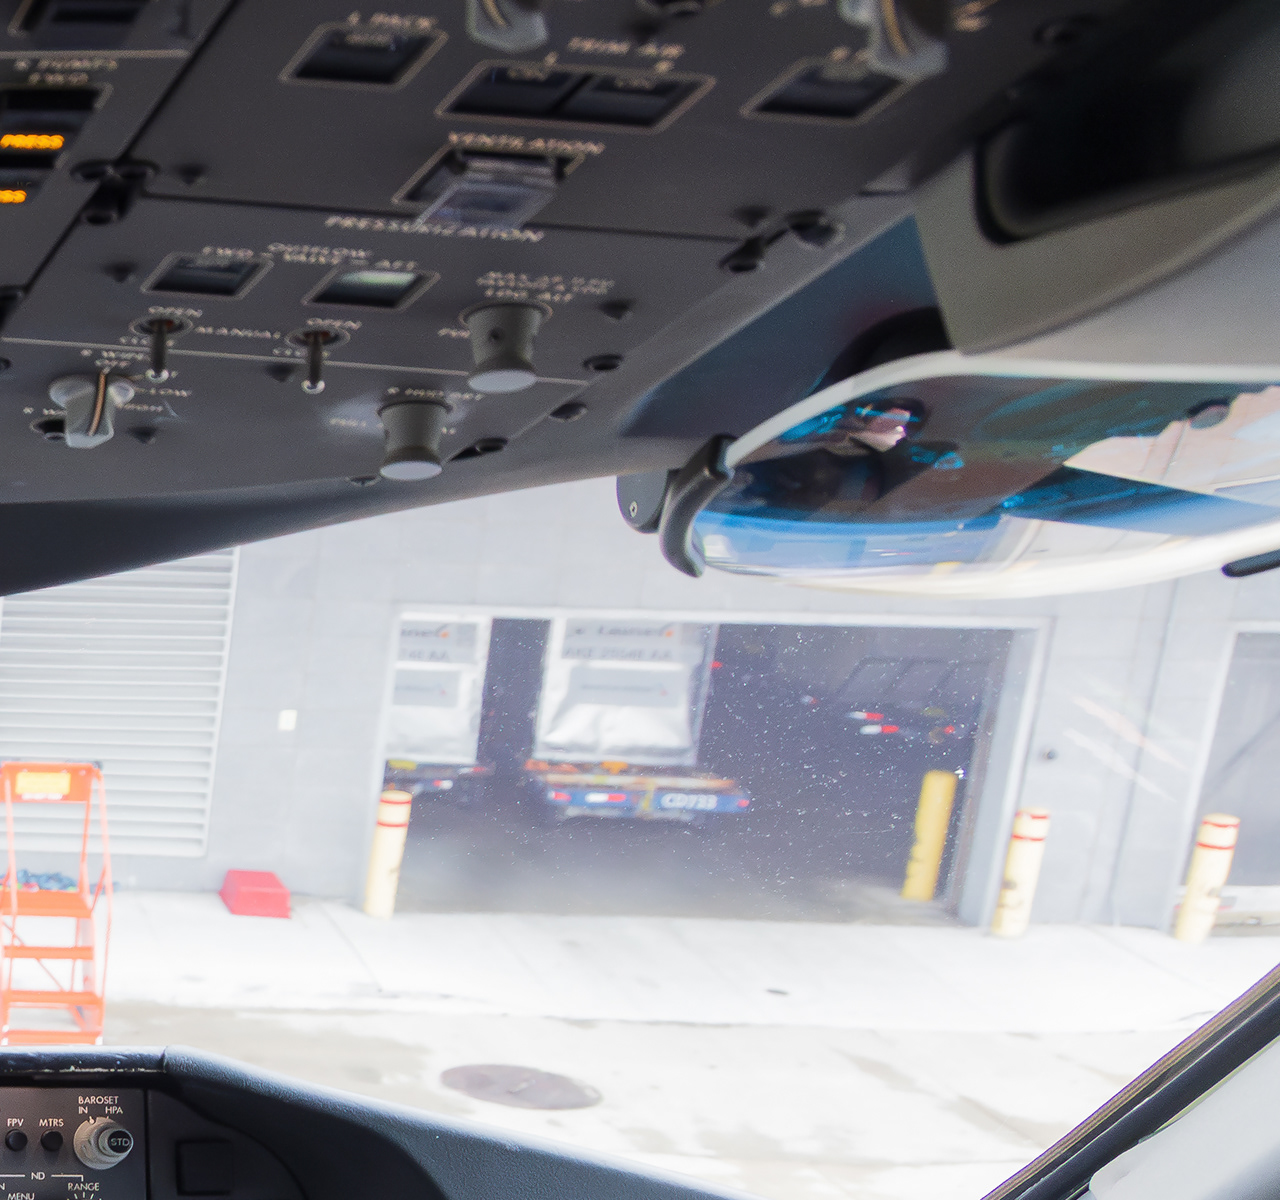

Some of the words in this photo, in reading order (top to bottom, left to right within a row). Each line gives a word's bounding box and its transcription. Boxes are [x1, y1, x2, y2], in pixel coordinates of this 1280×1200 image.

[449, 132, 604, 154] VENTILATION
[325, 213, 544, 242] PRESSURIZATION
[79, 1096, 118, 1104] BAROSET
